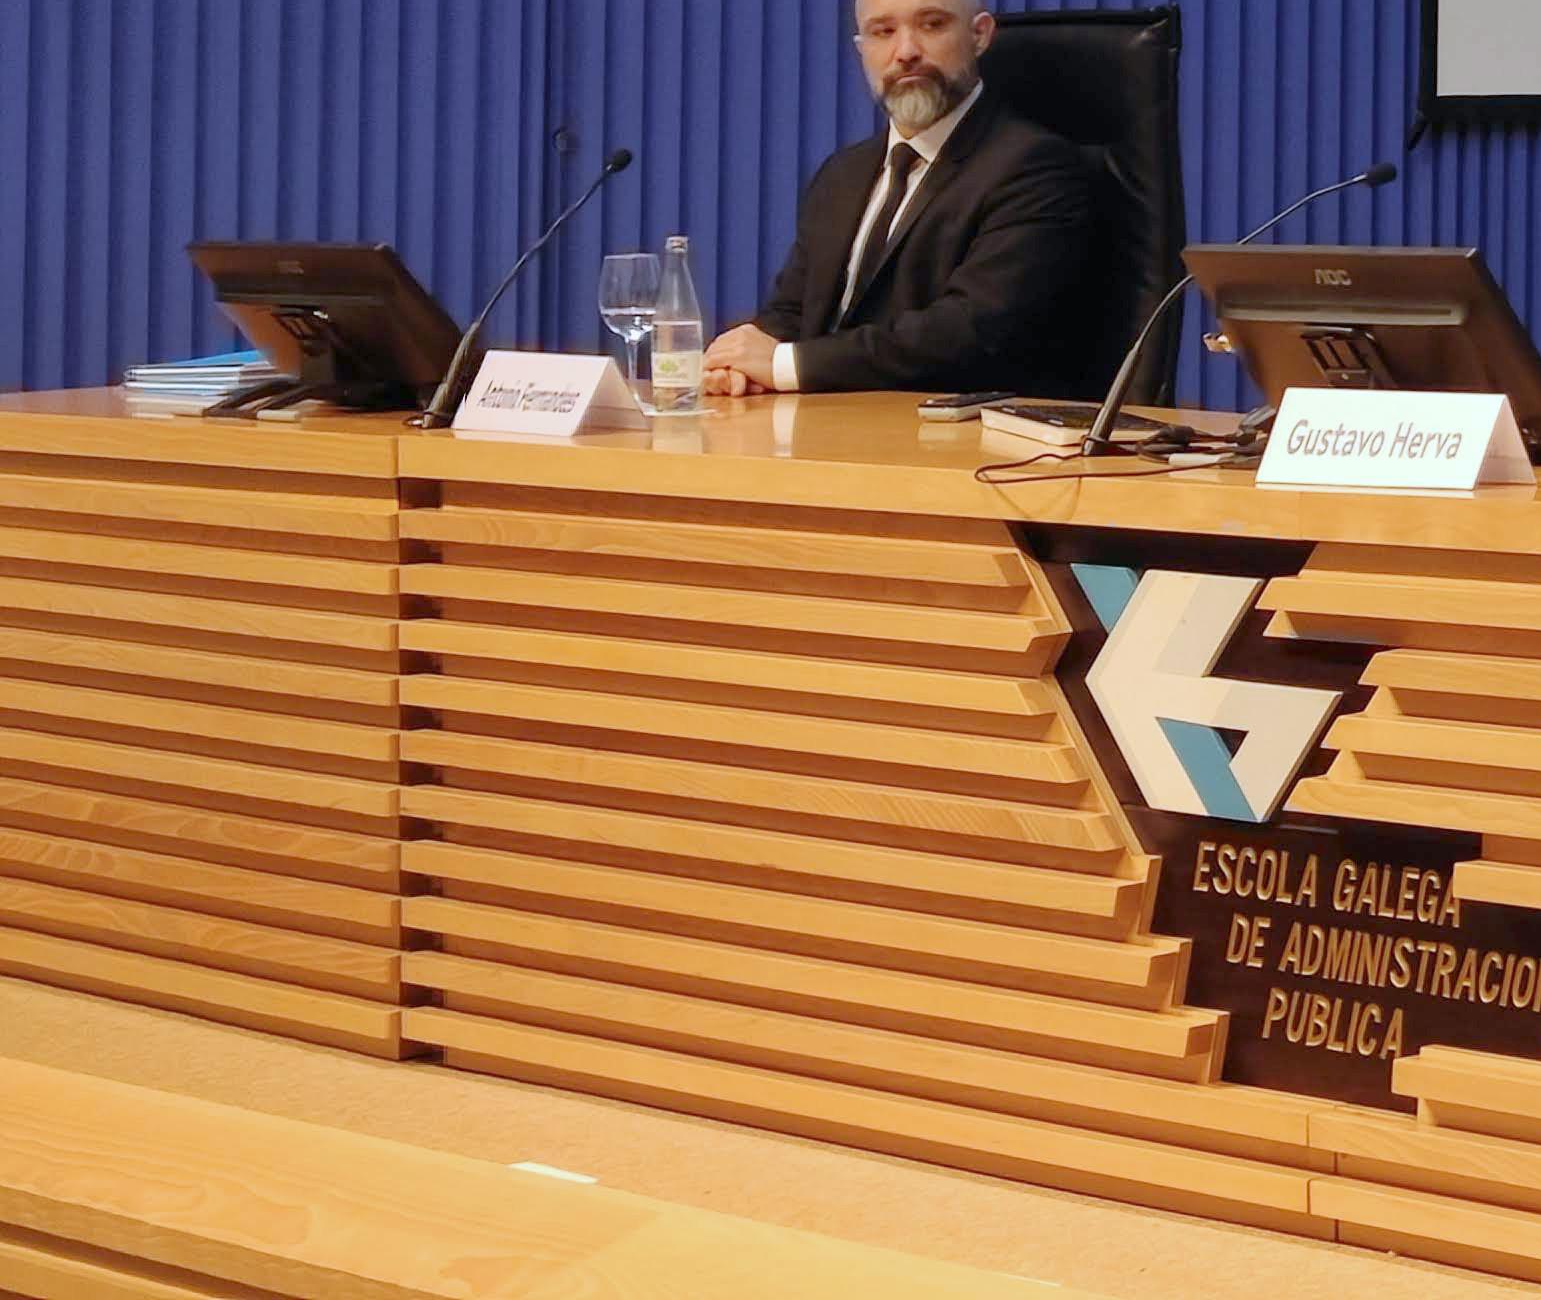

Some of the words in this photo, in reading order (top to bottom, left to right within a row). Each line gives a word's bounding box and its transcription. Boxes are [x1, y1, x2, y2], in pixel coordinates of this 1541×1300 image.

[1286, 419, 1385, 458] Gustavo
[1388, 421, 1463, 460] Herva
[1193, 841, 1318, 908] ESCOLA
[1333, 858, 1460, 929] GALEGA
[1226, 912, 1271, 968] DE
[1262, 987, 1403, 1060] PUBLICA
